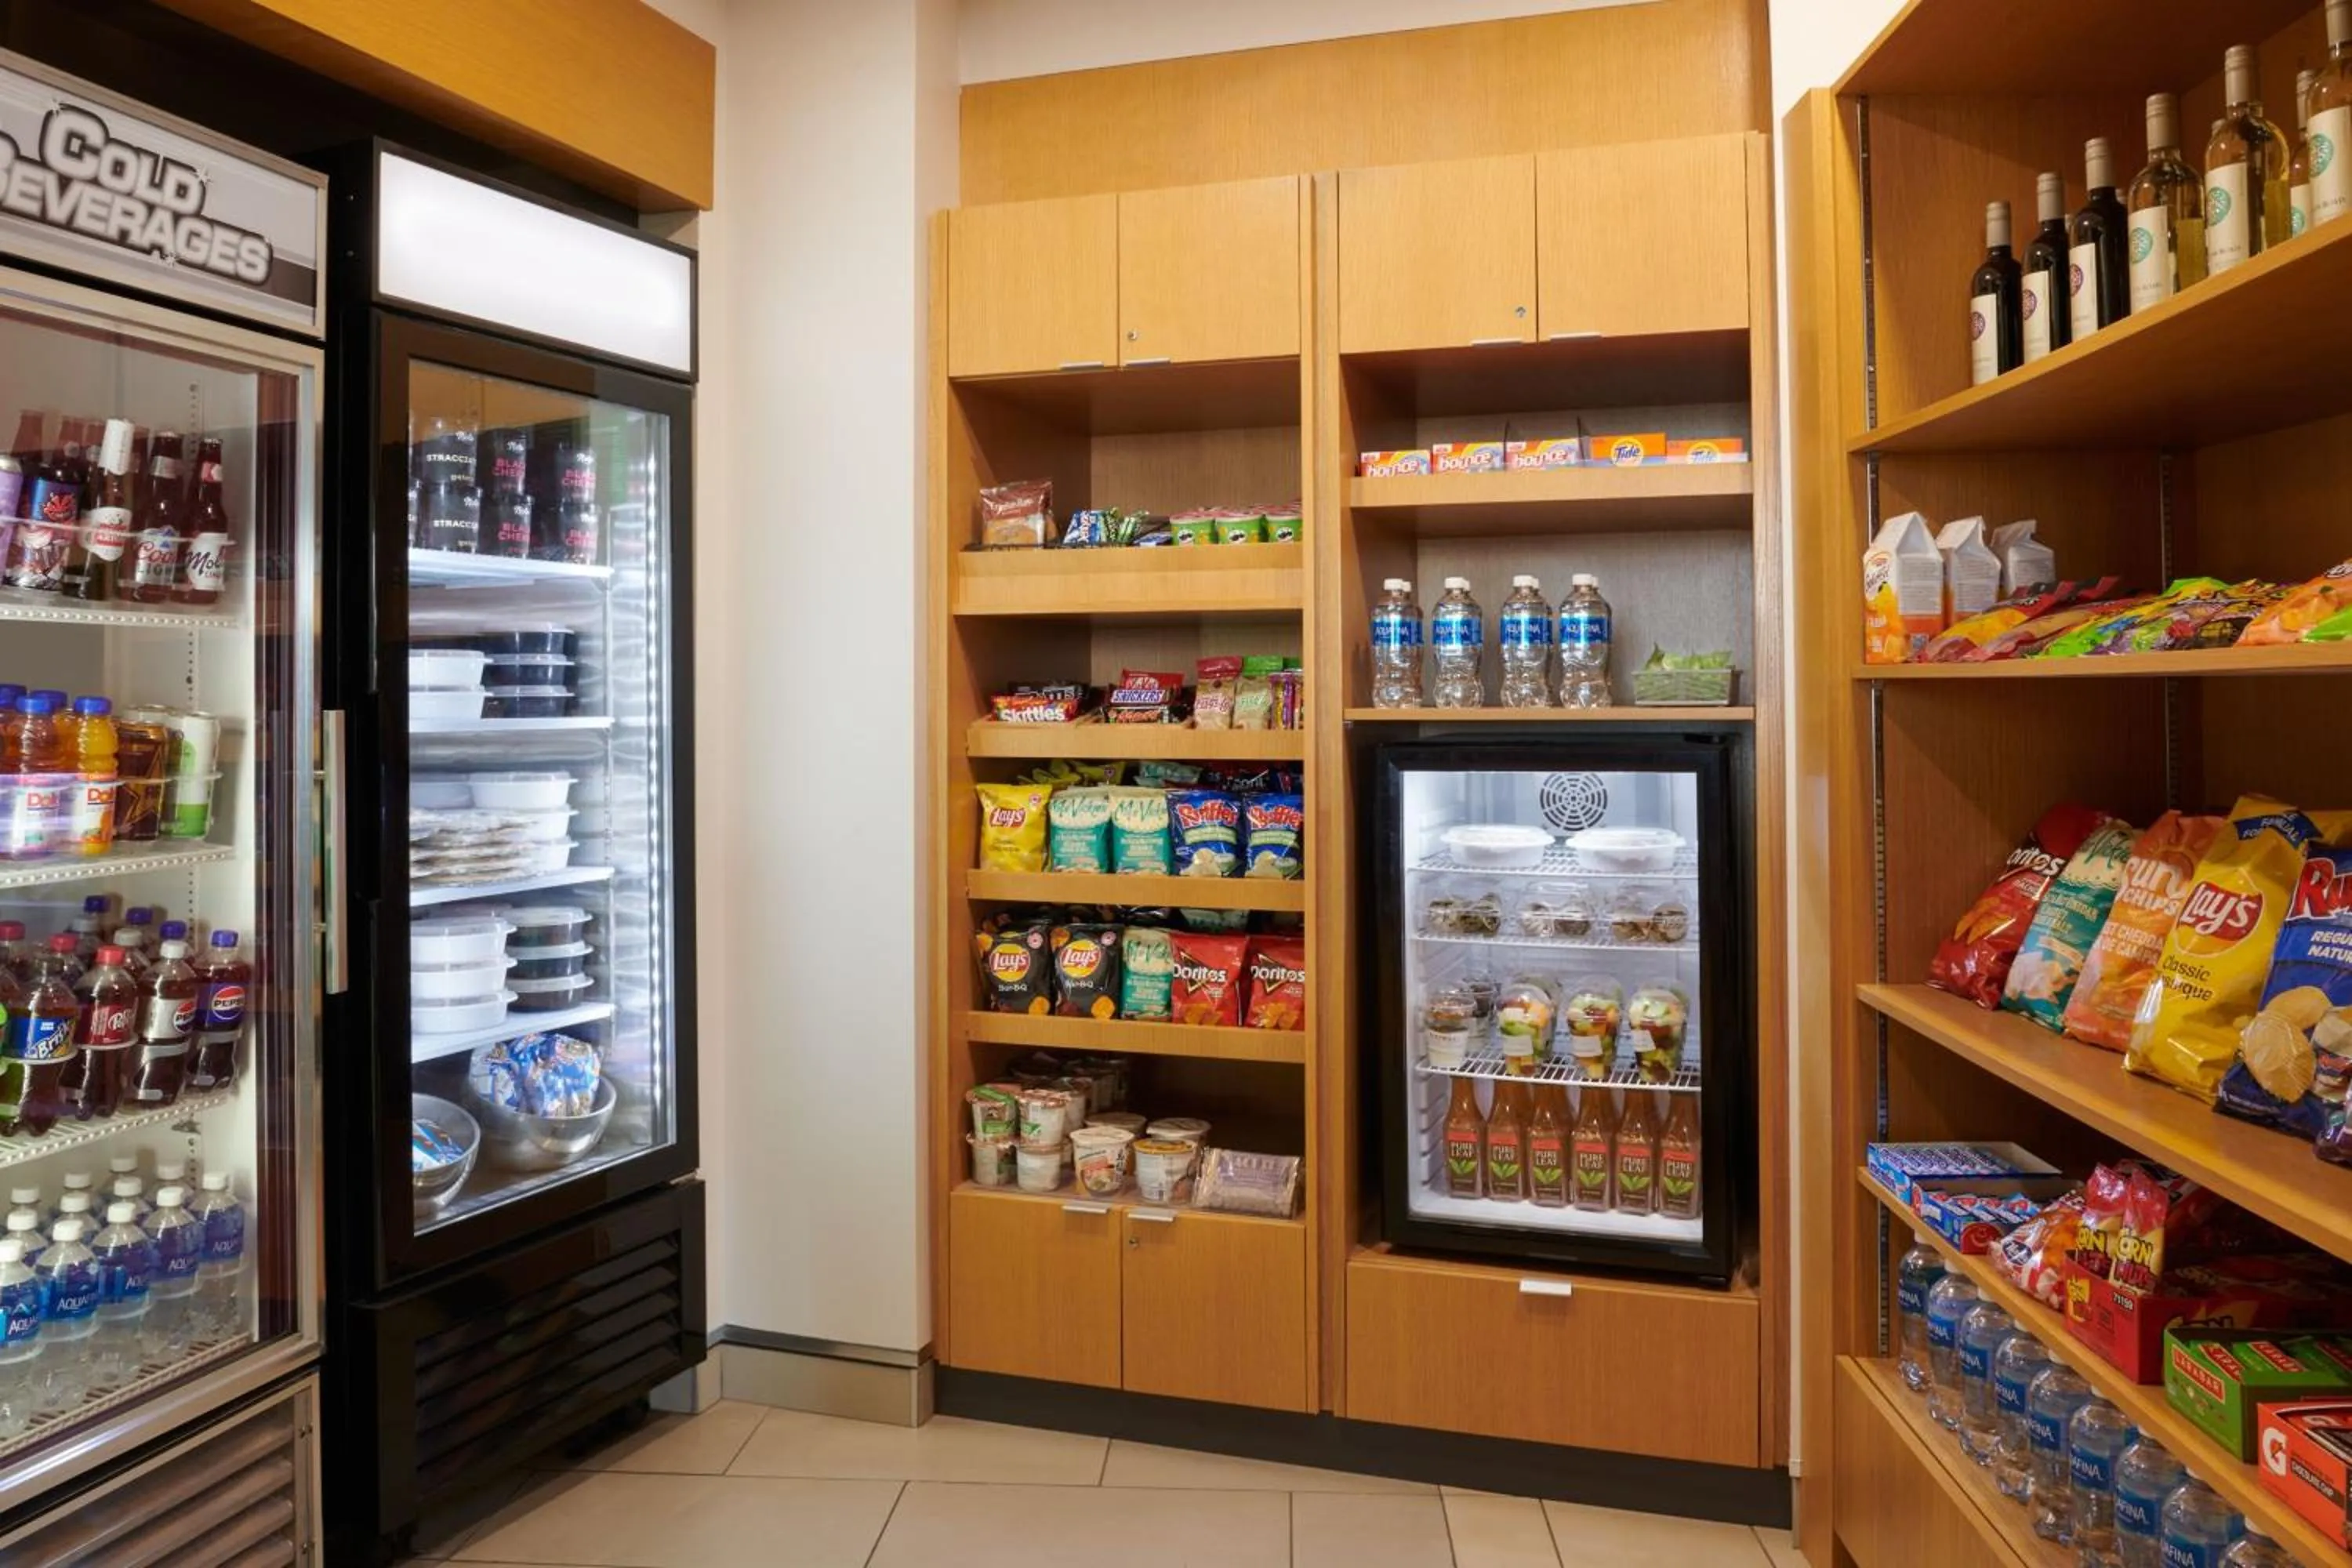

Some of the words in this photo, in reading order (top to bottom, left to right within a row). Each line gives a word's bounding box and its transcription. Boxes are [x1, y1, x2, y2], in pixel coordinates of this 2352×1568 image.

[43, 105, 205, 216] COLD
[1615, 445, 1641, 461] Tide
[1000, 706, 1065, 722] Skittles
[2180, 884, 2258, 935] Lay's
[2310, 931, 2352, 946] REGU
[2307, 945, 2352, 964] NATUR
[1173, 964, 1227, 982] Doritos
[2162, 954, 2212, 982] Classic
[2263, 1427, 2287, 1477] G
